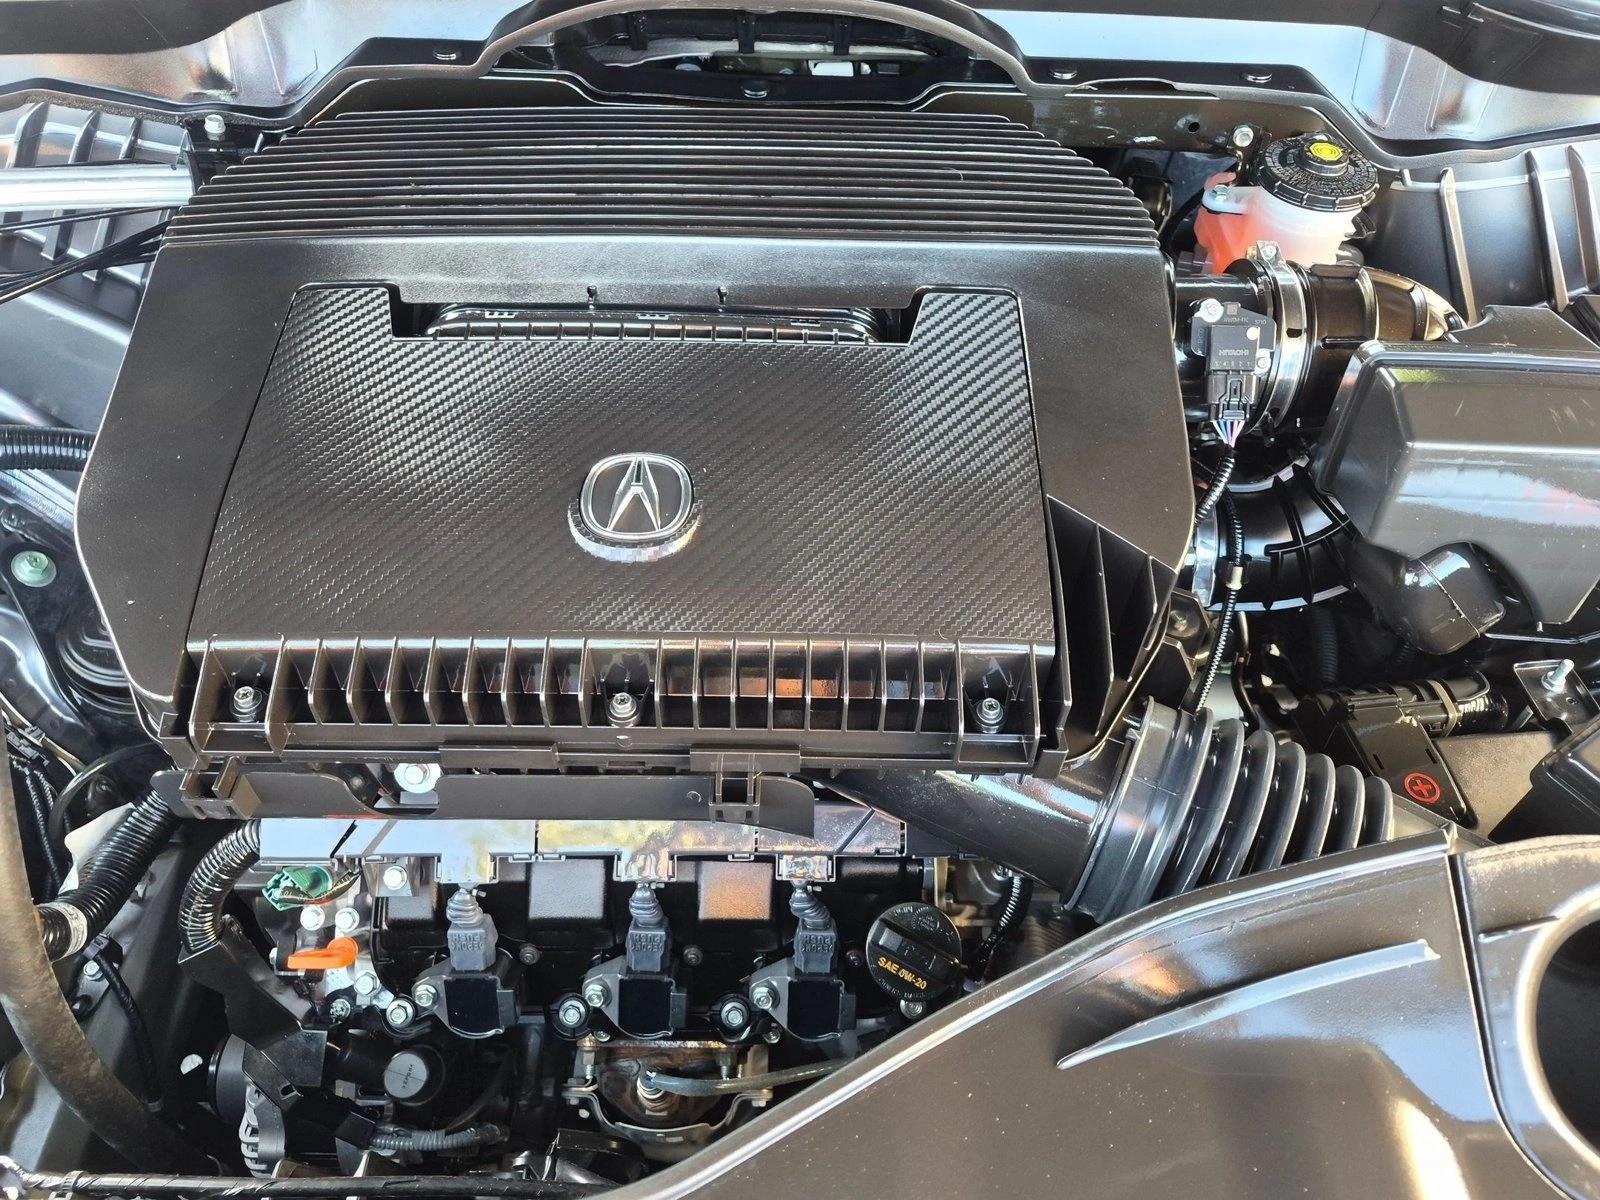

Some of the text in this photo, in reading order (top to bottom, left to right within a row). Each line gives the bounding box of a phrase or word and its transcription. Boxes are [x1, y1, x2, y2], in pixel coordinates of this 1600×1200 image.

[452, 933, 480, 942] PUSH
[633, 934, 661, 943] PUSH
[803, 935, 831, 944] PUSH
[877, 956, 900, 975] SAE
[898, 968, 928, 990] 0W-20
